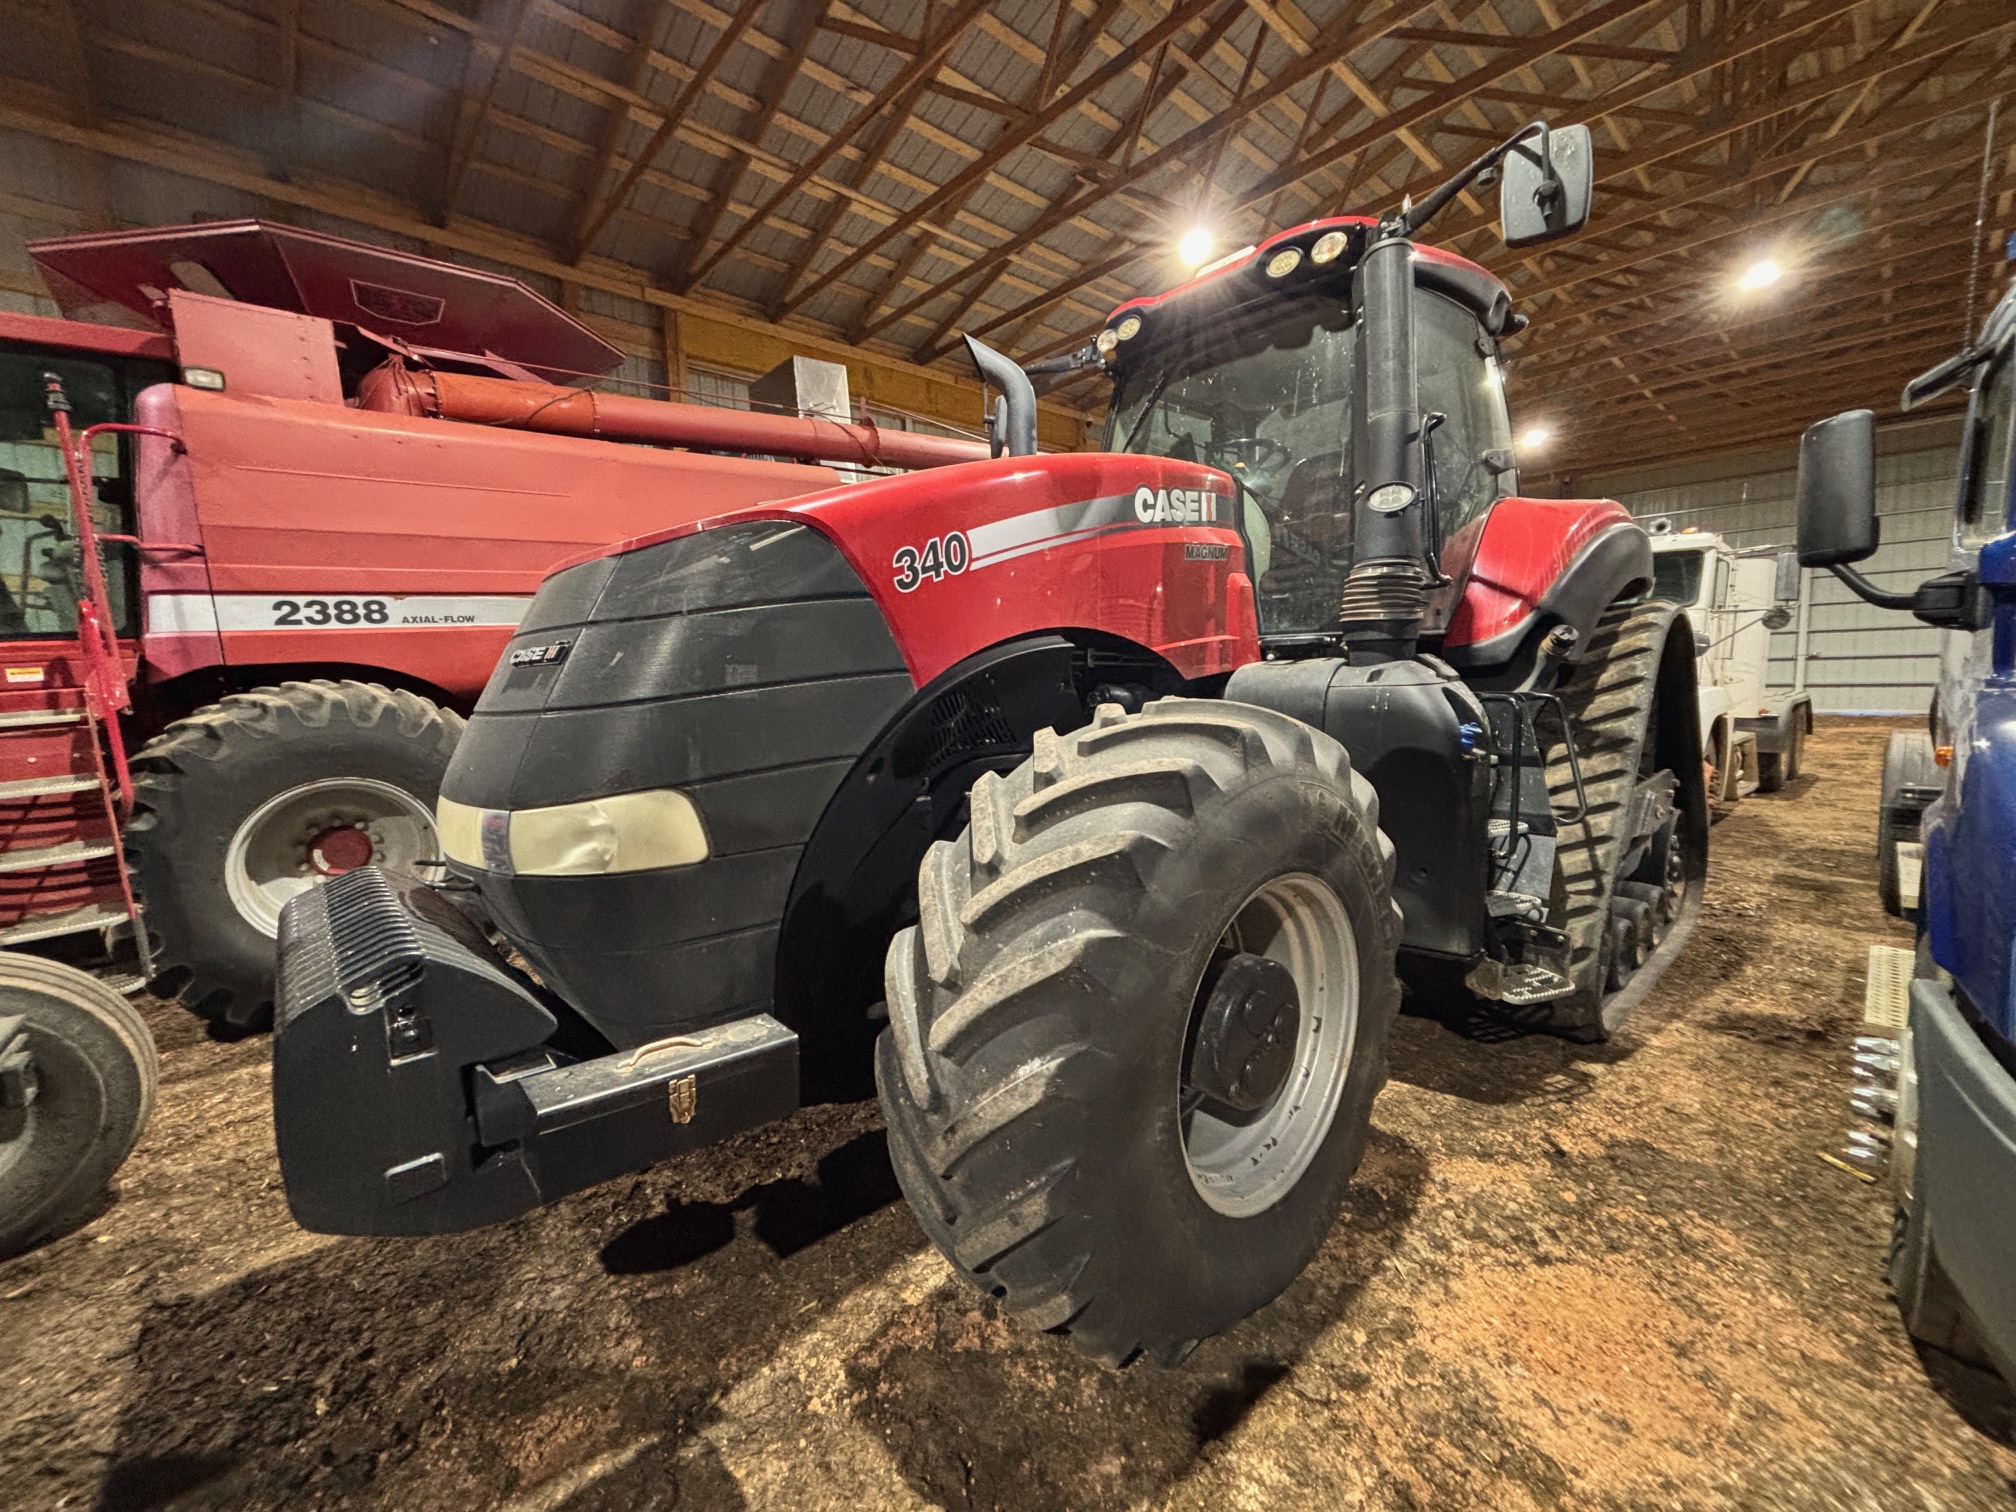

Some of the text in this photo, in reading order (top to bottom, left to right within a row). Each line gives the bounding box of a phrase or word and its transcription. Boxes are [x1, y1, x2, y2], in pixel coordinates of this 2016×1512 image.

[893, 531, 969, 593] 340
[1185, 545, 1229, 560] MAGNUM
[272, 600, 475, 626] 2388 AXIAL-FLOW
